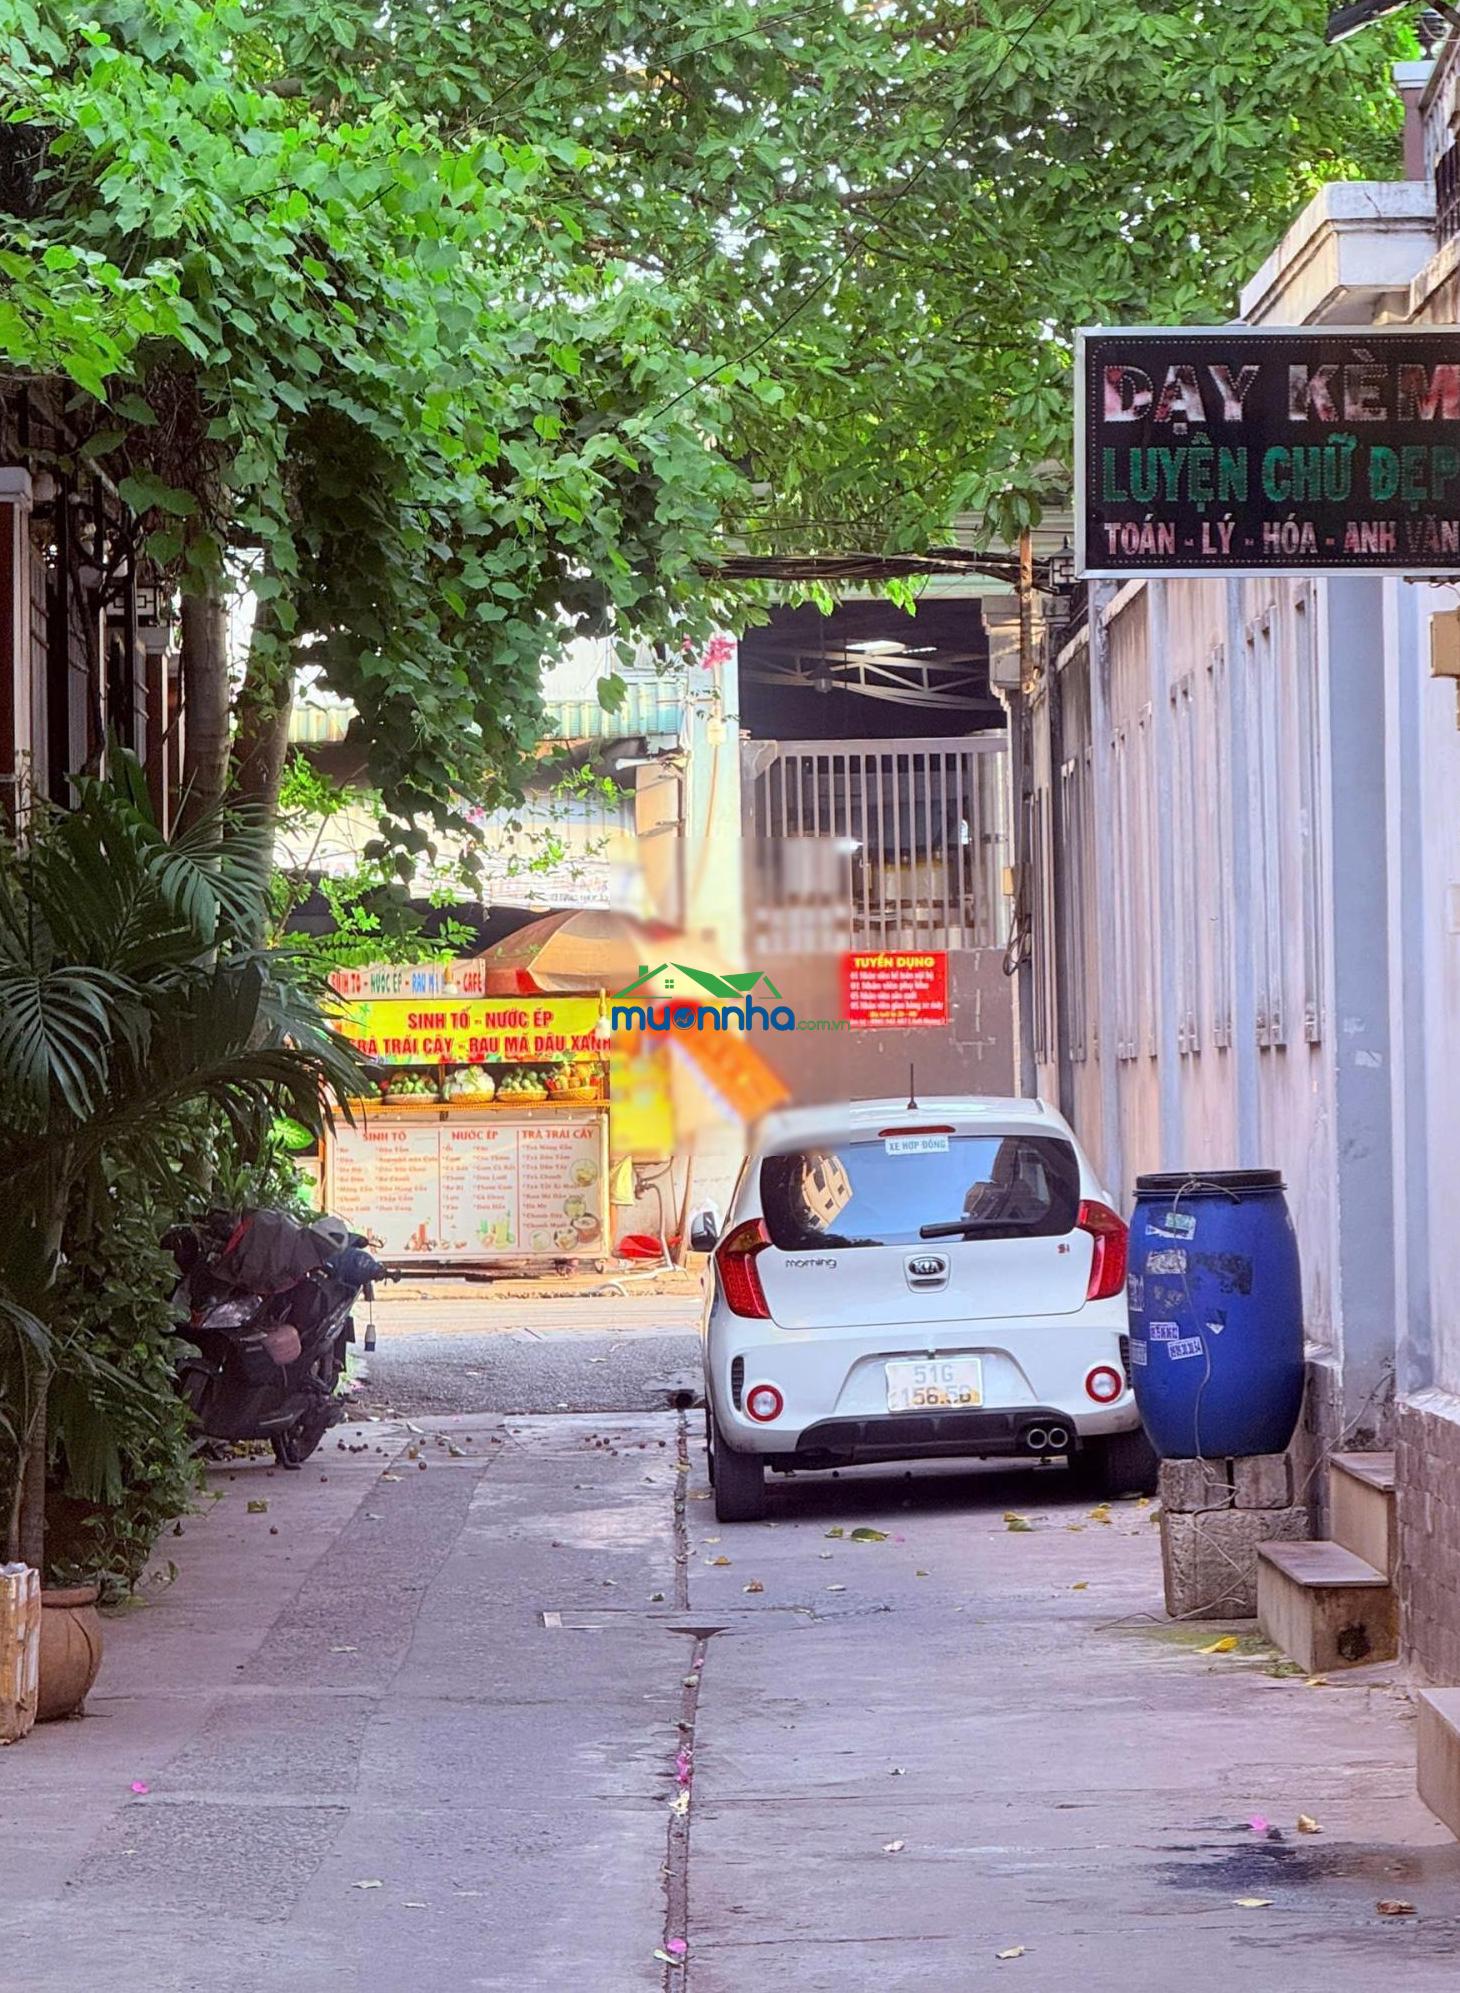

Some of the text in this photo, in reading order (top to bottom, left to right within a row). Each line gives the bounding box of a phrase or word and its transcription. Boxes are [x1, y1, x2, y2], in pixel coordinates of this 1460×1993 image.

[1103, 348, 1460, 434] DẠY KÈM
[1102, 432, 1460, 513] LUYỆN CHỮ ĐẸP
[1104, 513, 1176, 555] TOÁN
[1201, 513, 1236, 555] LÝ
[1263, 512, 1318, 554] HÓA
[1343, 520, 1396, 554] ANH
[408, 1004, 553, 1029] SINH TỐ NƯỚC ÉP
[383, 1034, 417, 1054] TRÁI
[423, 1034, 453, 1053] CÂY
[469, 1036, 498, 1053] RAU
[505, 1033, 528, 1053] MÁ
[785, 1259, 838, 1270] morning
[913, 1261, 942, 1274] KIA
[914, 1364, 953, 1384] 51G
